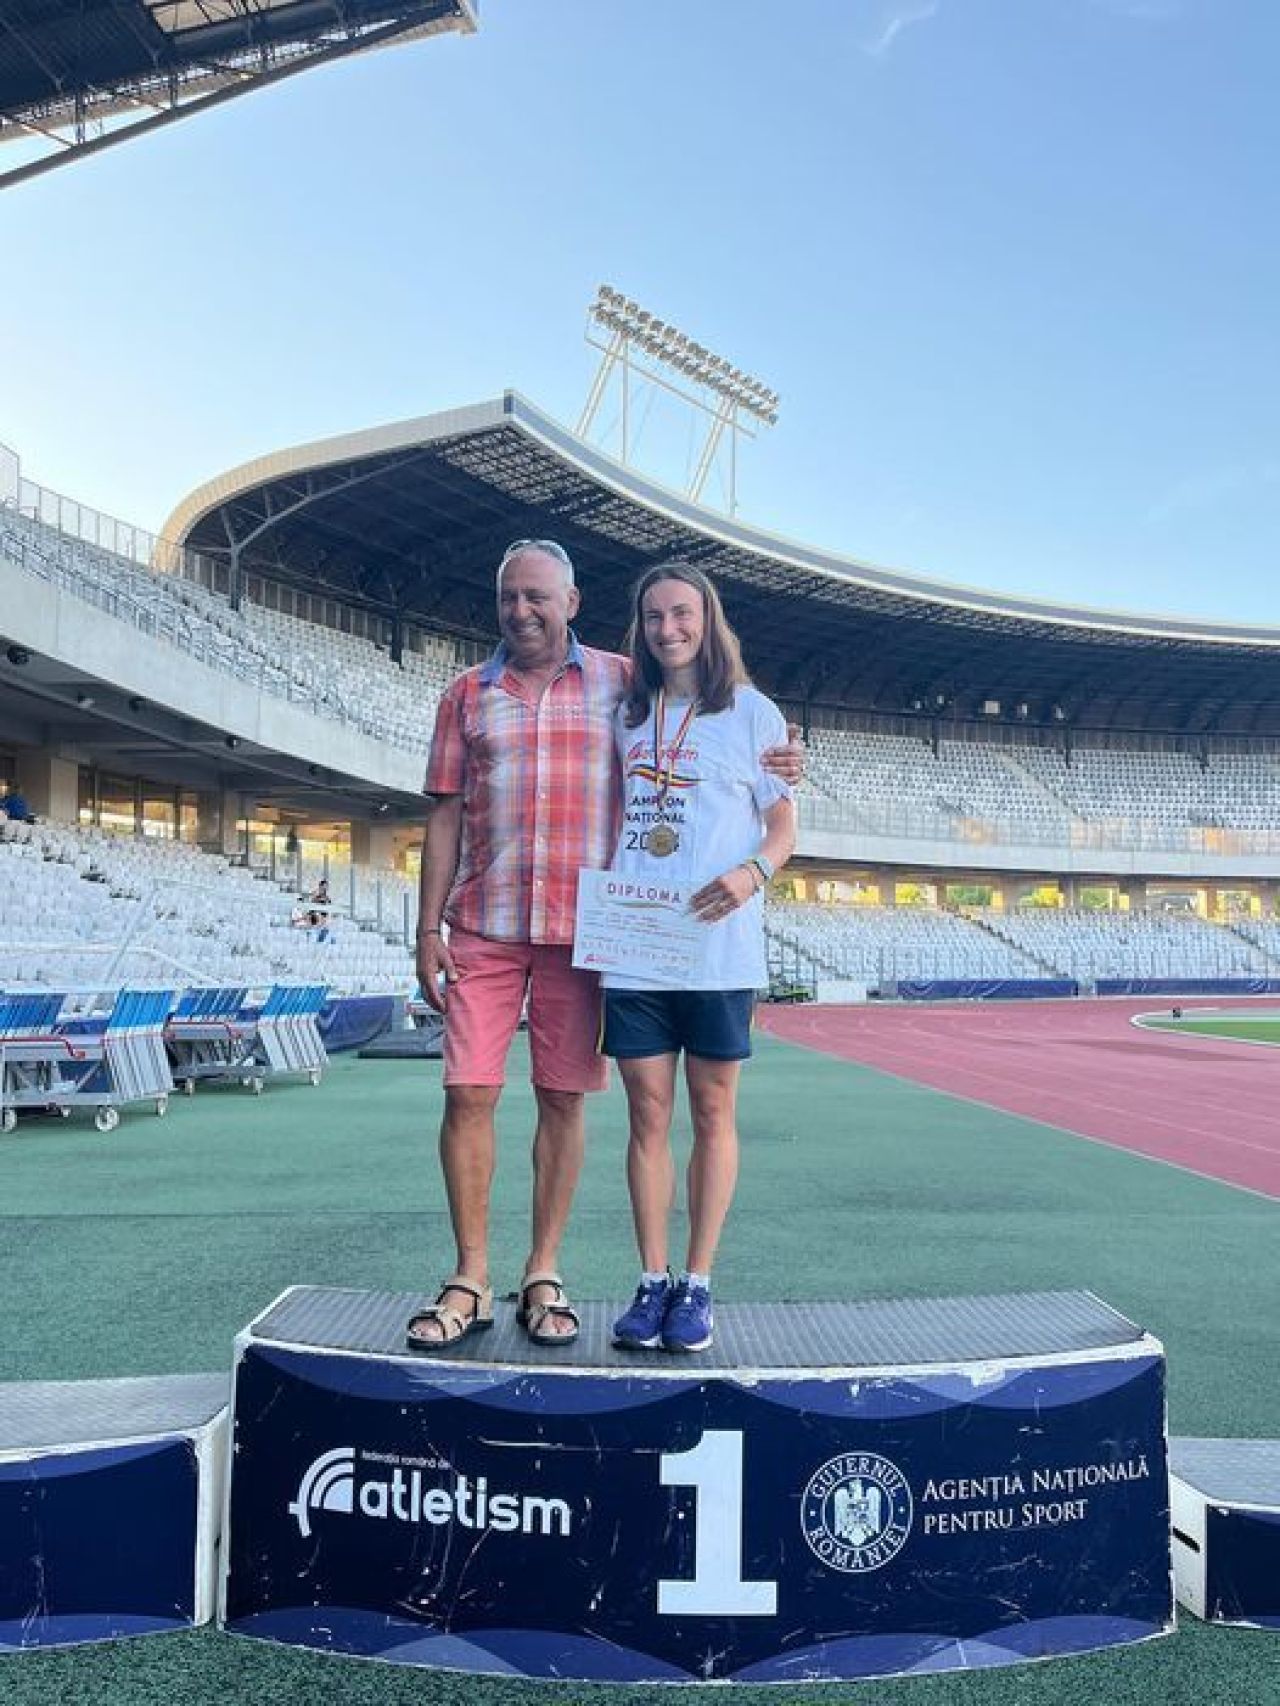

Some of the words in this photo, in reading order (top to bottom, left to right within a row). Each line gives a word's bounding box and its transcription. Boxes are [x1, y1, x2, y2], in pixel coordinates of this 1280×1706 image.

[627, 795, 684, 808] AMPON
[625, 830, 680, 851] 20
[607, 883, 682, 903] DIPLOMA
[811, 1457, 904, 1498] GUVERNUL
[359, 1468, 571, 1536] atletism
[924, 1509, 1014, 1535] PENTRU
[1021, 1499, 1089, 1526] SPORT
[657, 1430, 778, 1615] 1
